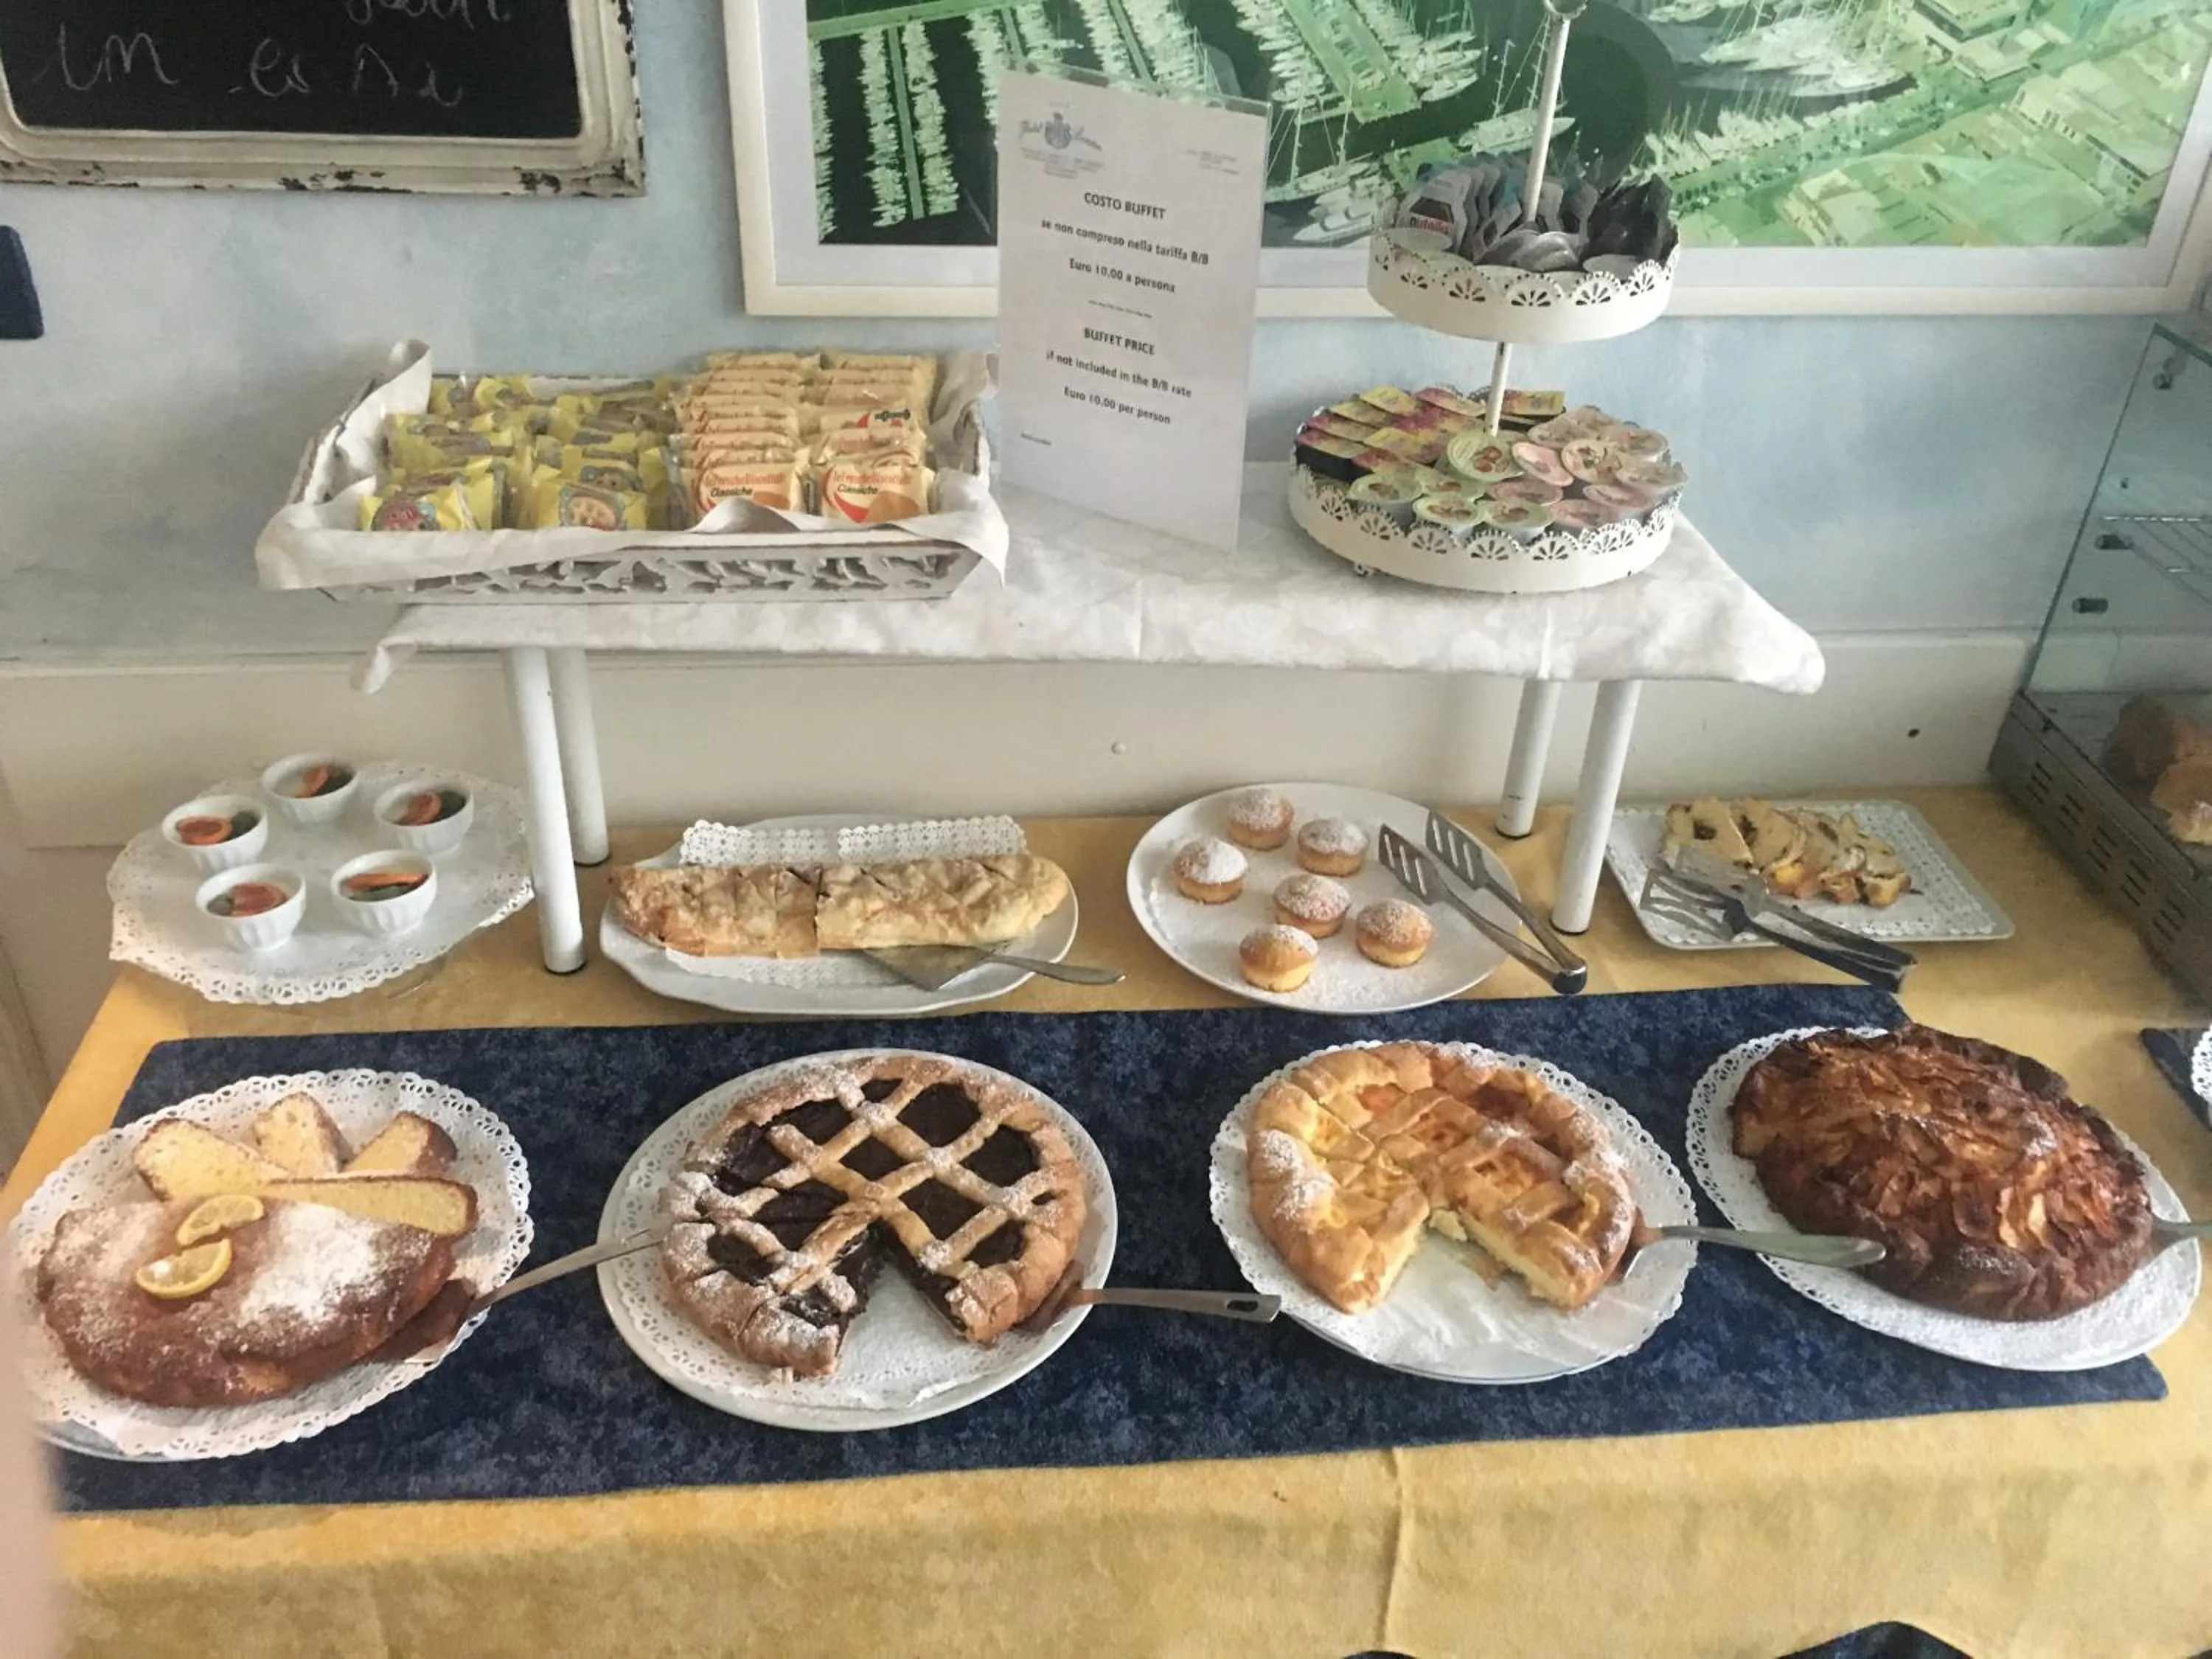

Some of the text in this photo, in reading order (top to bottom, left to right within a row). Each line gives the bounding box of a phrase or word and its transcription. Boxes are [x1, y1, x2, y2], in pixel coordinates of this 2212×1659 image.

[1084, 192, 1166, 220] COSTO BUFFET
[1041, 219, 1208, 265] se non compreso nella tariffa B/B
[1070, 257, 1092, 273] Euro
[1134, 276, 1175, 293] persona
[1084, 327, 1155, 355] BUFFET PRICE
[1046, 350, 1192, 398] if not included in the B/B rate
[1064, 386, 1086, 401] Euro
[1119, 403, 1135, 414] per
[1136, 408, 1171, 425] person
